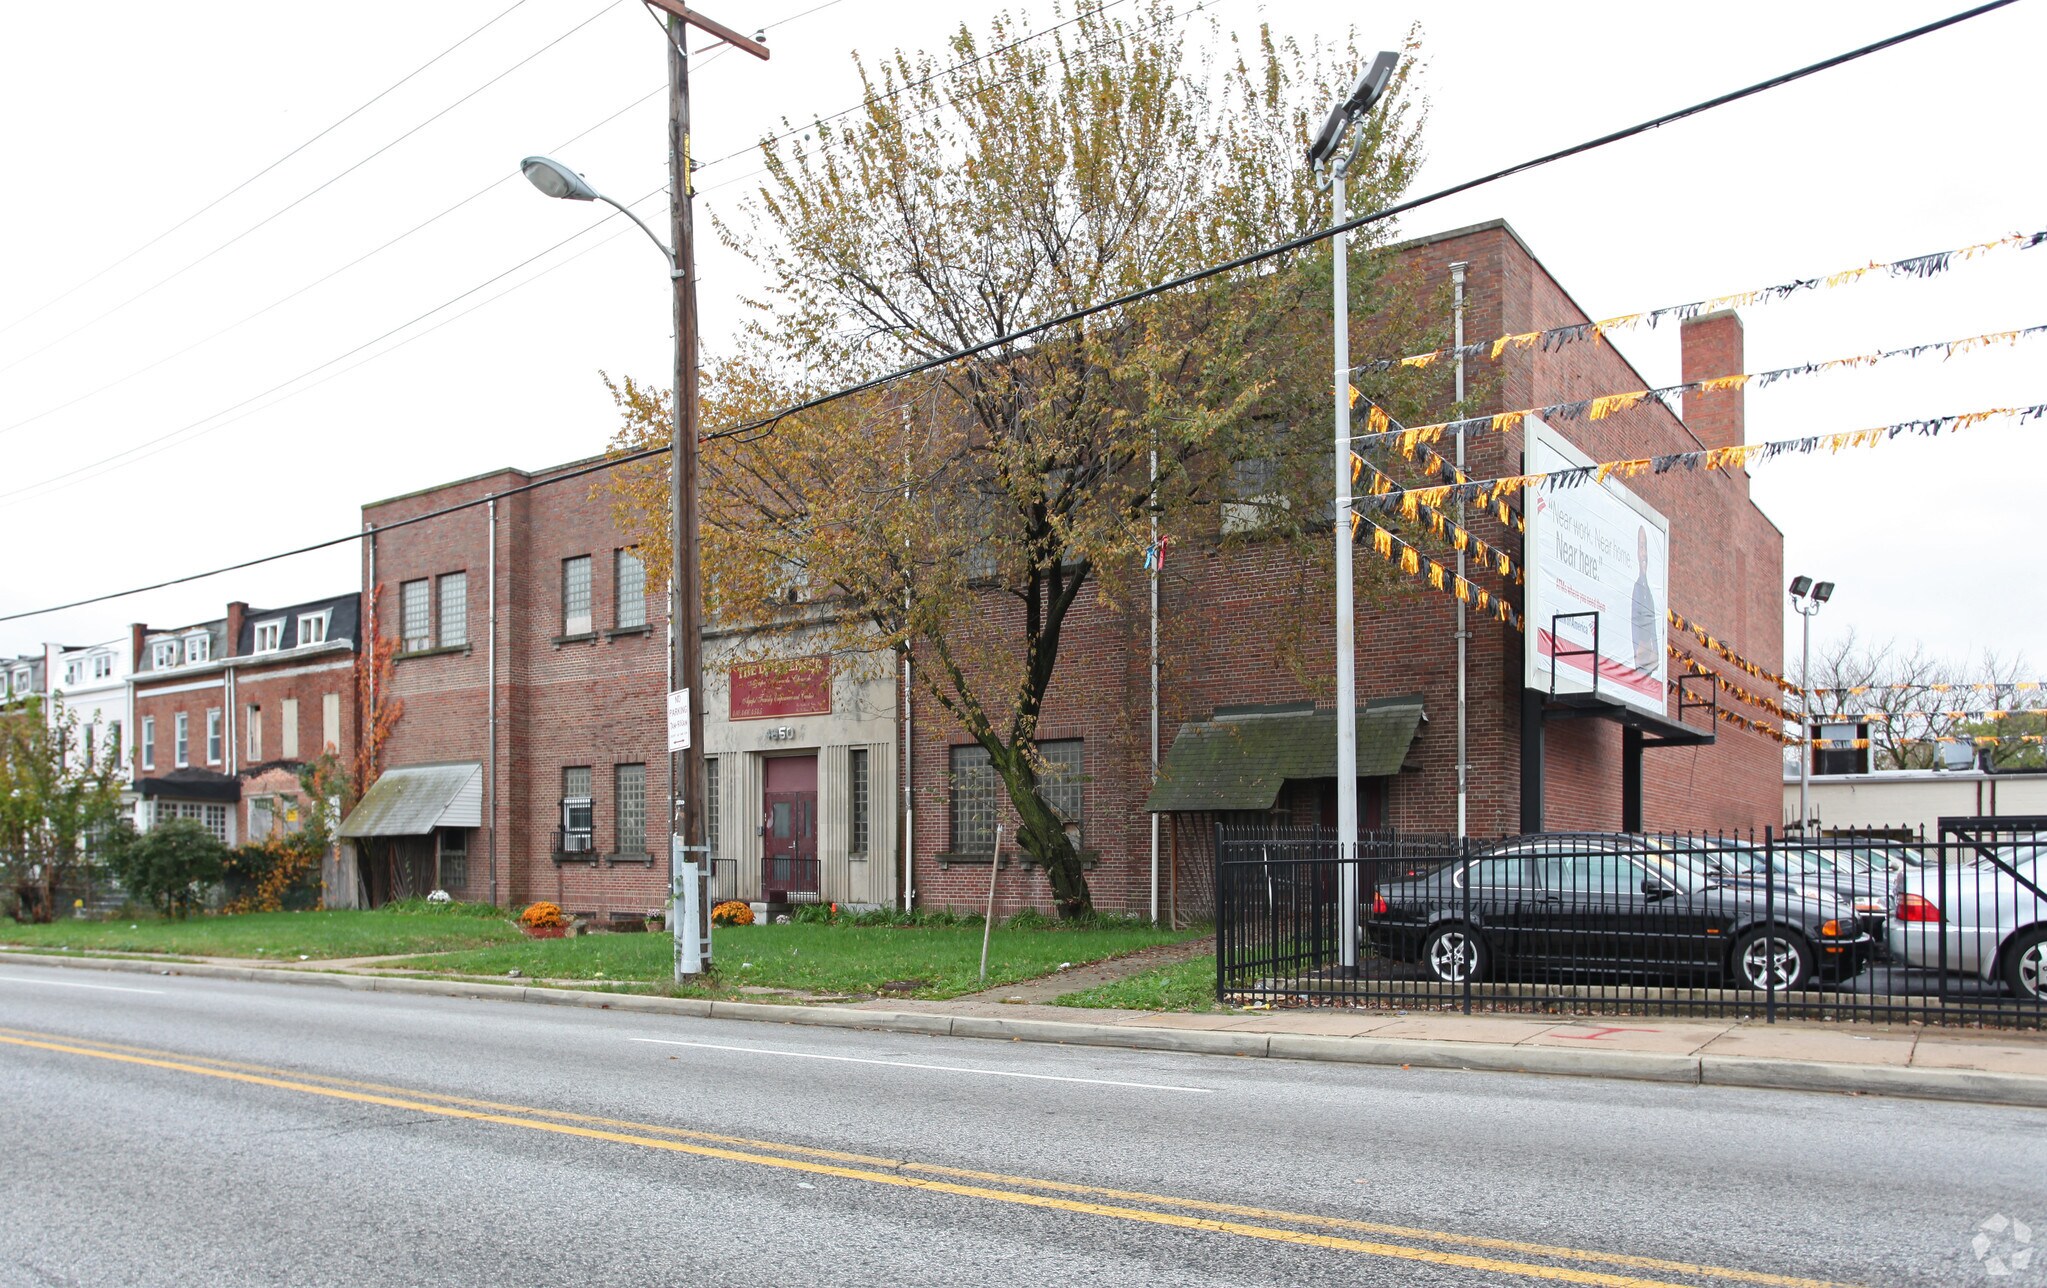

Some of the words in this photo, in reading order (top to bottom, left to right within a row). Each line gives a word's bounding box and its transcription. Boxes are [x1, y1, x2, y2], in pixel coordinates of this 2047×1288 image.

[1556, 530, 1577, 569] Near
[1594, 527, 1613, 555] Near
[674, 695, 681, 703] NO
[669, 705, 687, 717] PARKING
